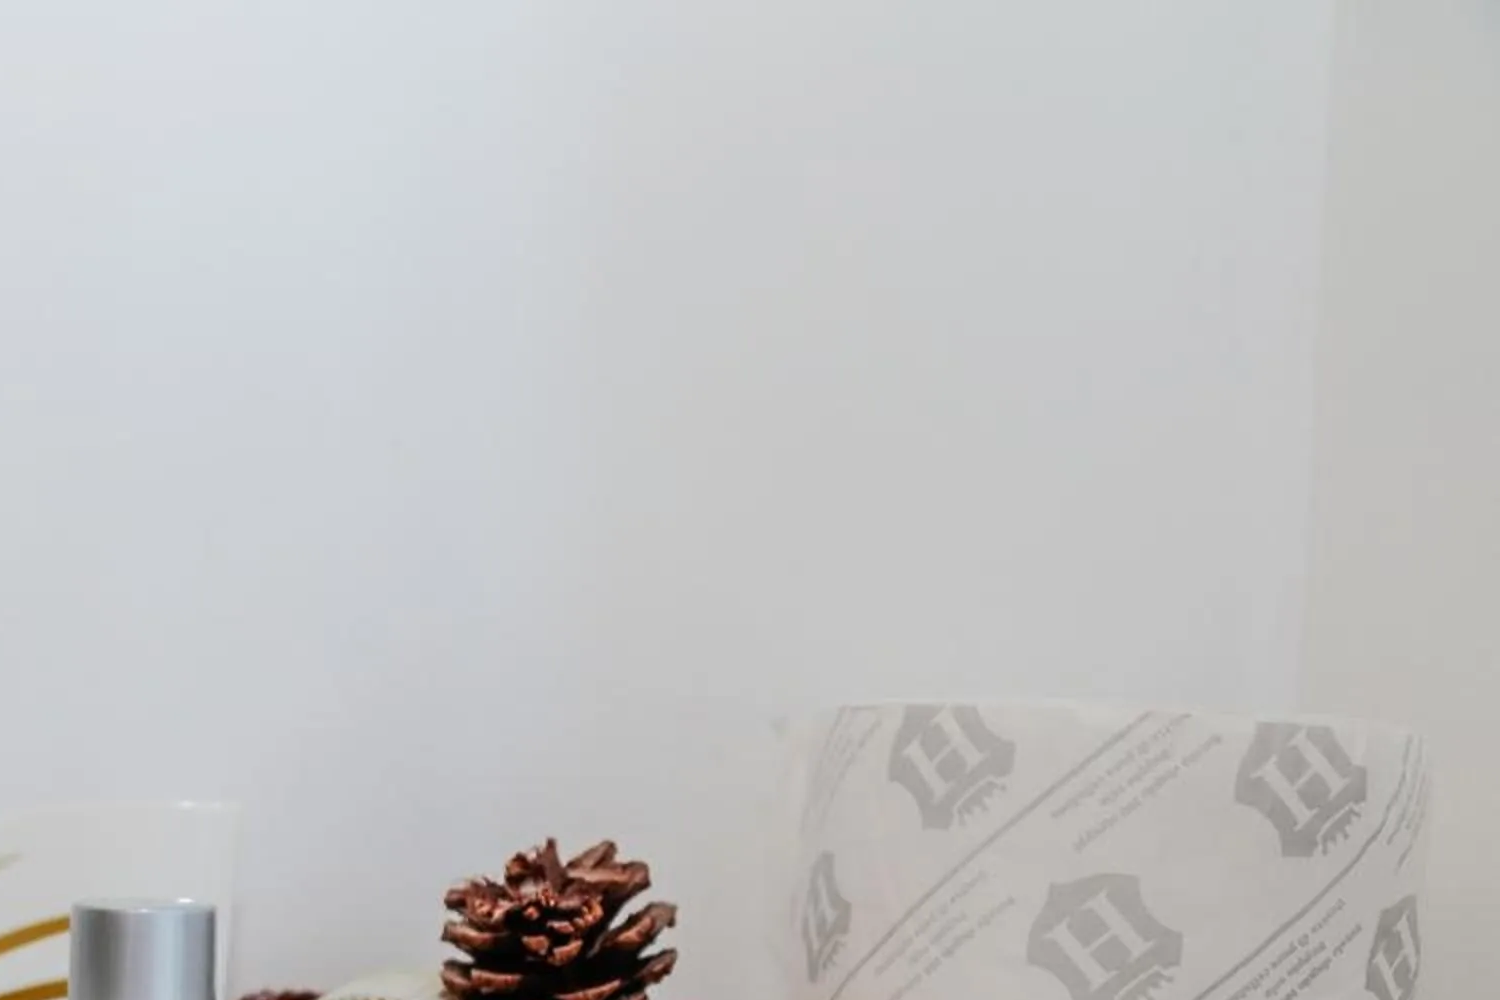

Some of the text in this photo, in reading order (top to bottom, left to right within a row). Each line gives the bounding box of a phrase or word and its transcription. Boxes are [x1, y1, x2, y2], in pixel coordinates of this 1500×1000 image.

[901, 707, 986, 806] H
[1255, 725, 1350, 831] H
[1045, 893, 1155, 992] H
